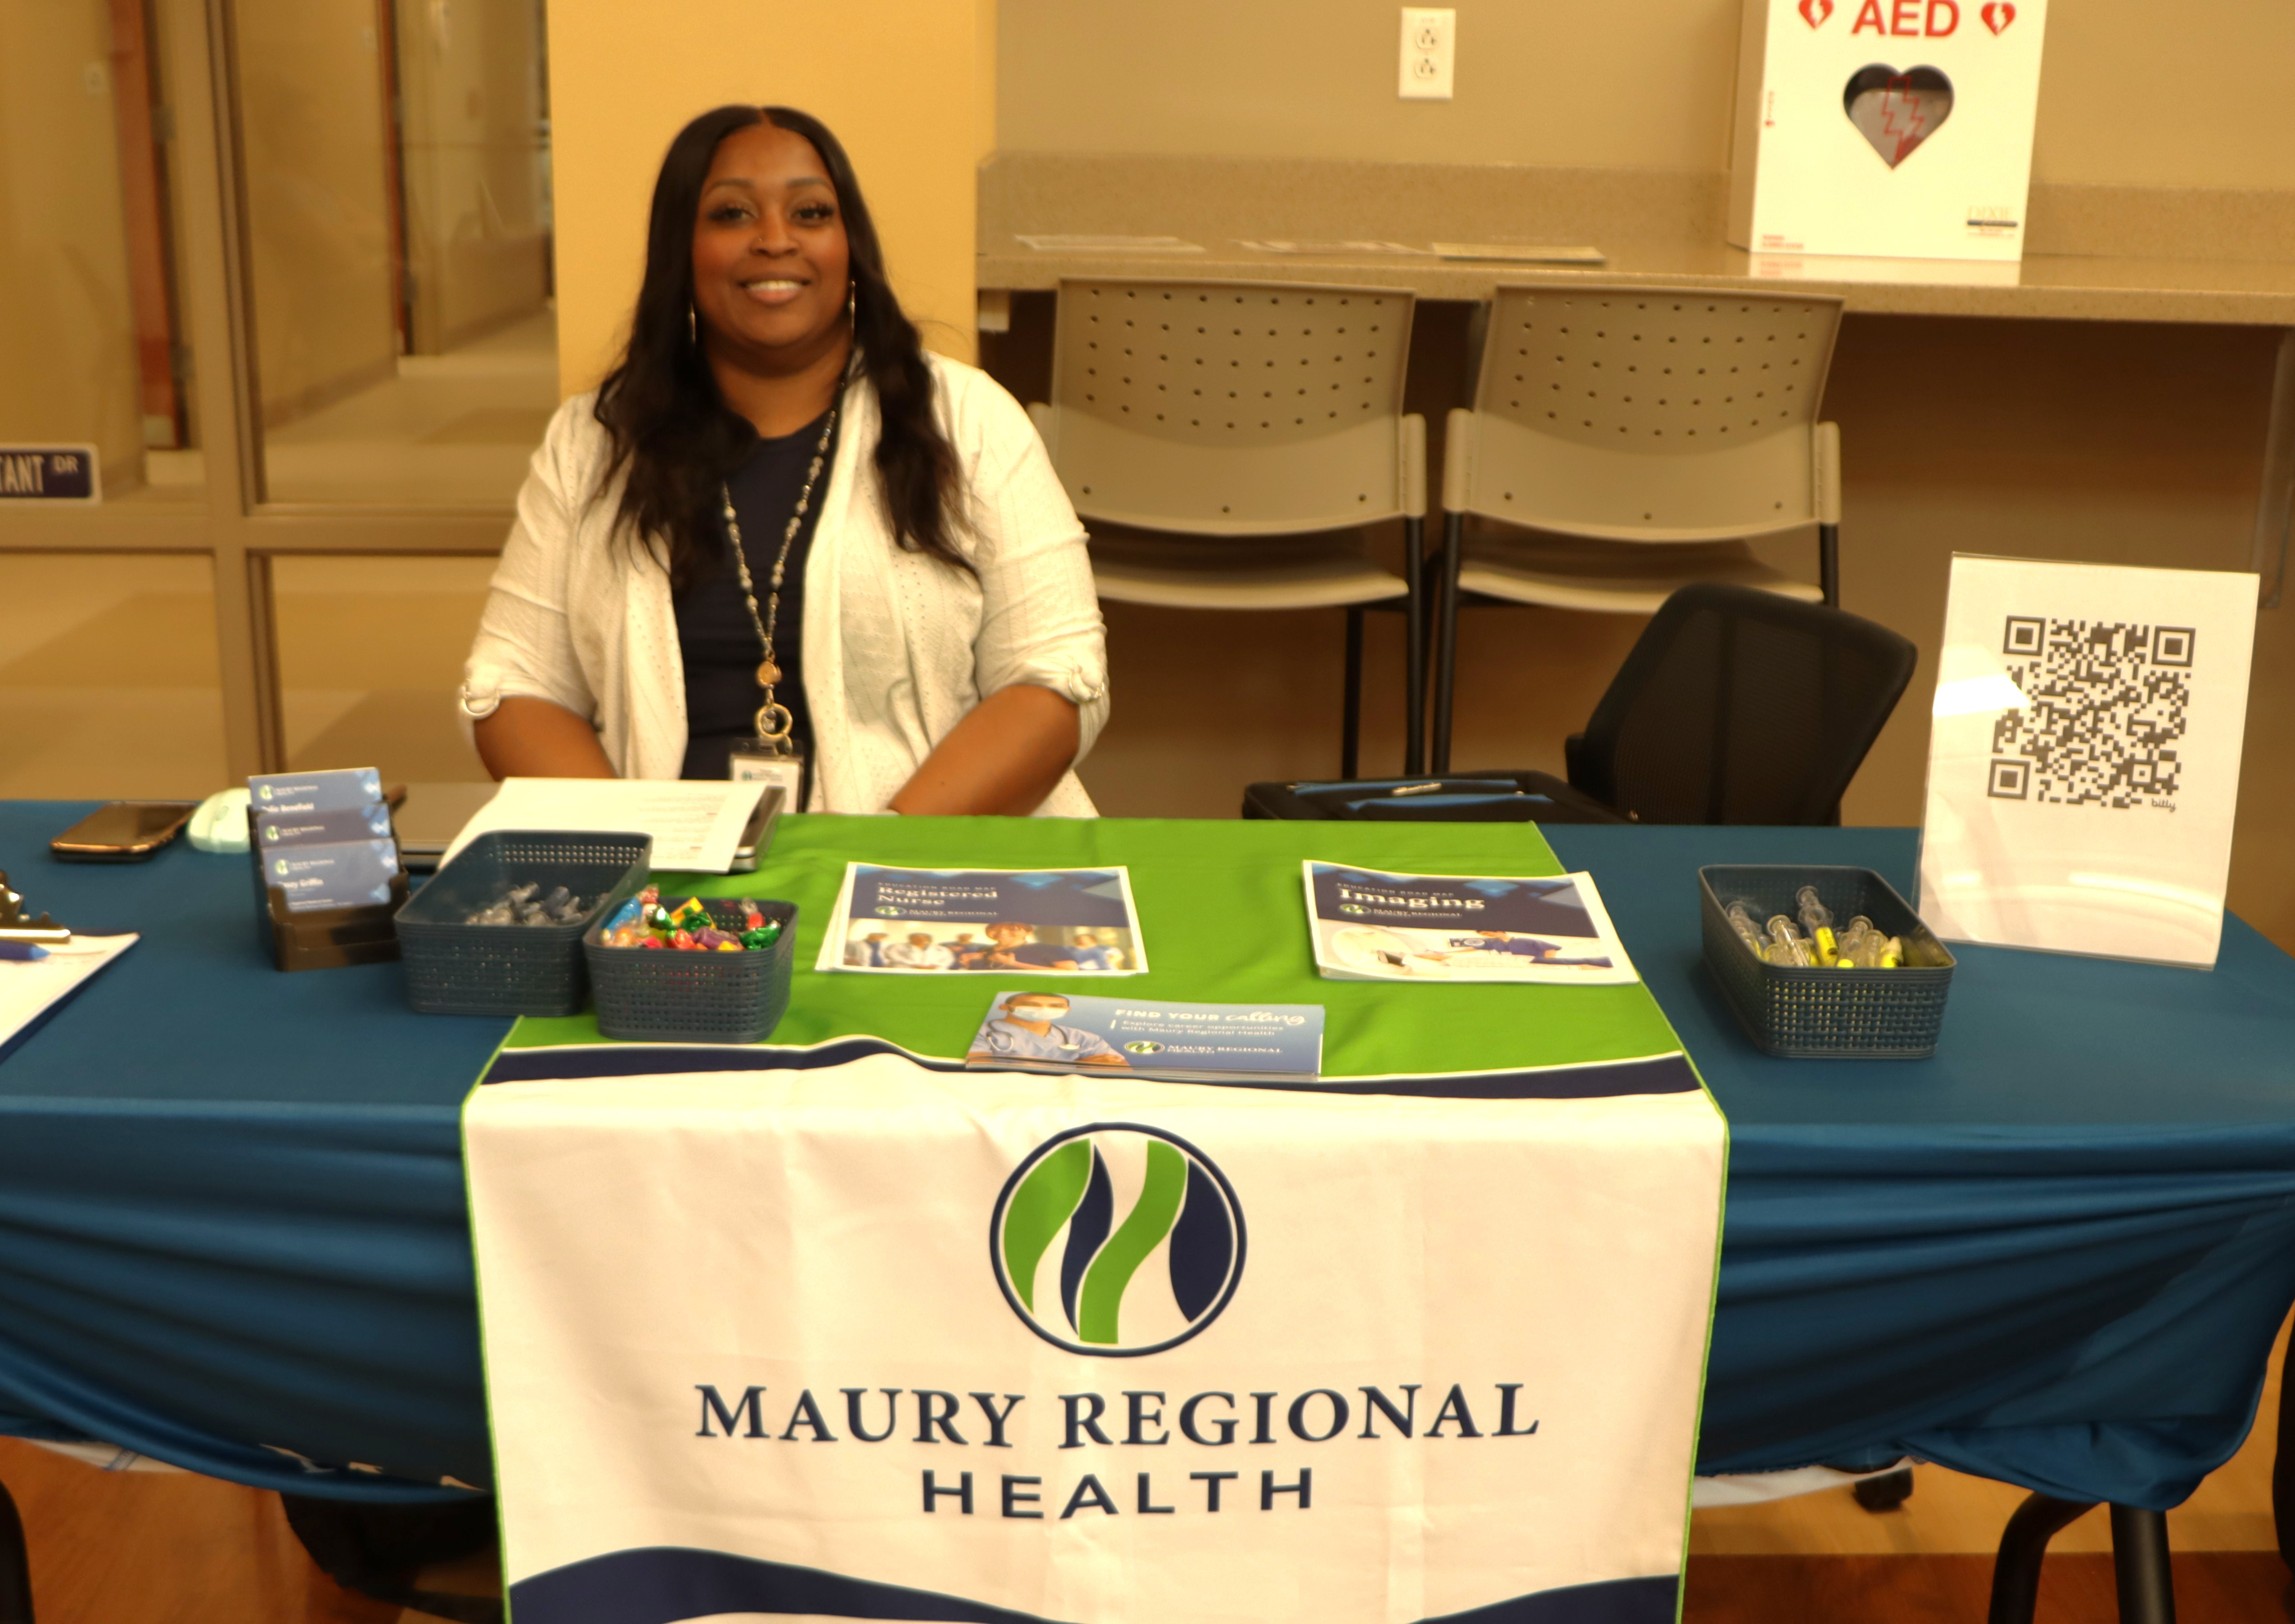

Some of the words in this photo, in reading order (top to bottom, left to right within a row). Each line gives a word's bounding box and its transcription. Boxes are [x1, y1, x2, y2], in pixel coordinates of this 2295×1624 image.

[1851, 0, 1960, 37] AED
[0, 454, 45, 493] ANT
[52, 455, 78, 472] DR
[878, 894, 945, 904] Nurse
[879, 886, 998, 898] Registered
[1339, 888, 1485, 909] Imaging
[1115, 1009, 1161, 1017] FIND
[1168, 1012, 1219, 1021] YOUR
[1225, 1012, 1306, 1026] calling
[694, 1384, 1026, 1448] MAURY
[1057, 1382, 1540, 1449] REGIONAL
[922, 1467, 1312, 1519] HEALTH
